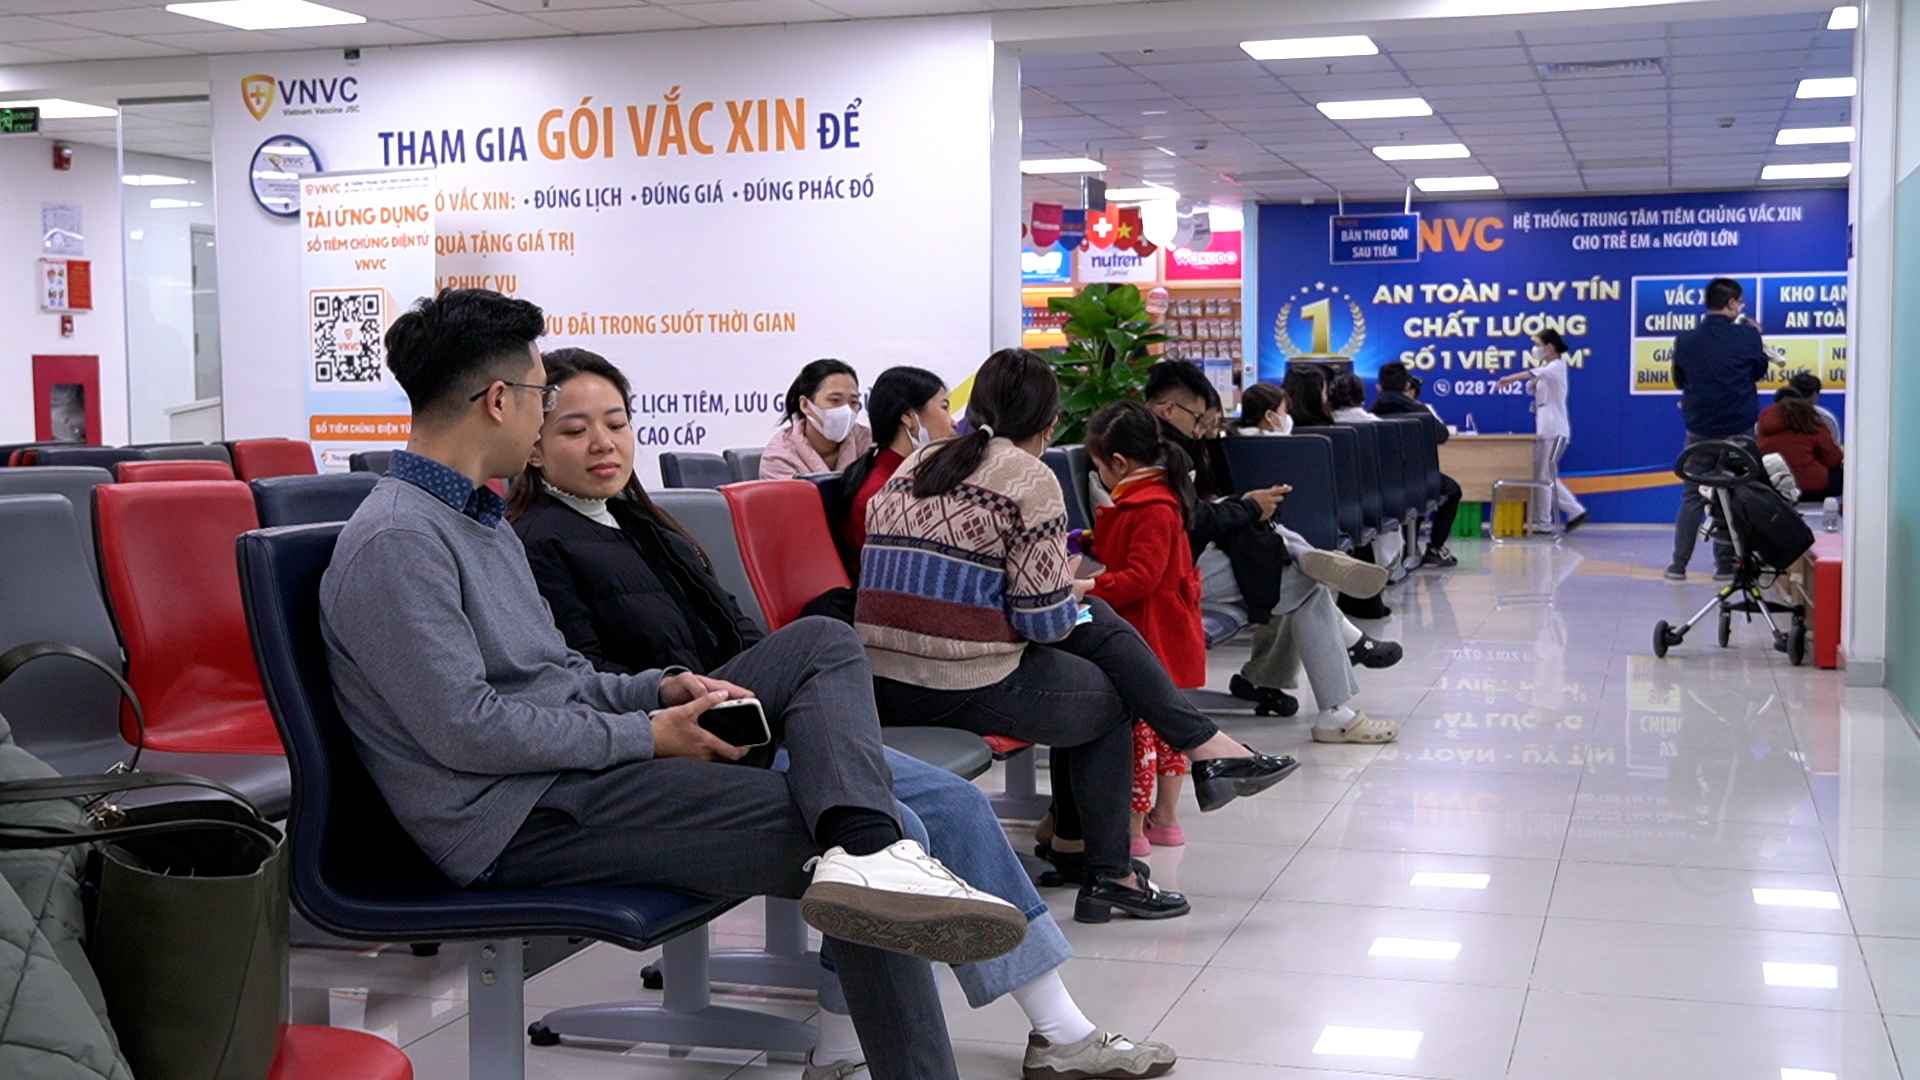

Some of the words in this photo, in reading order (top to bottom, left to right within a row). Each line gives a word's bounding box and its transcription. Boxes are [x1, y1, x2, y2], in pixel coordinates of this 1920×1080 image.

[278, 76, 358, 105] VNVC
[282, 108, 312, 116] Vietnam
[315, 107, 343, 115] Vaccine
[378, 129, 466, 167] THAM
[475, 126, 528, 163] GIA
[537, 96, 614, 160] GÓI
[626, 85, 715, 157] VẮC
[726, 97, 806, 153] XIN
[817, 97, 863, 150] ĐỂ
[449, 186, 479, 211] VẮC
[482, 191, 516, 211] XIN:
[534, 186, 580, 209] ĐÚNG
[586, 187, 622, 213] LỊCH
[642, 182, 690, 205] ĐÚNG
[695, 180, 724, 203] GIÁ
[743, 178, 793, 202] ĐÚNG
[799, 176, 845, 200] PHÁC
[306, 205, 331, 228] TẢI
[335, 204, 377, 227] ỨNG
[380, 204, 429, 229] DỤNG
[1513, 211, 1530, 233] HỆ
[1533, 209, 1578, 229] THỐNG
[1581, 210, 1627, 228] TRUNG
[1630, 207, 1660, 226] TÂM
[1661, 206, 1695, 225] TIÊM
[1697, 204, 1746, 224] CHỦNG
[1777, 205, 1803, 222] XIN
[435, 231, 467, 256] QUÀ
[470, 229, 513, 258] TẶNG
[517, 230, 545, 252] GIÁ
[549, 231, 575, 256] TRỊ
[1363, 227, 1389, 241] THEO
[1419, 216, 1504, 252] NVC
[1572, 234, 1600, 250] CHO
[1601, 229, 1627, 249] TRẺ
[1630, 233, 1650, 248] EM
[1663, 228, 1708, 248] NGƯỜI
[1711, 227, 1738, 246] LỚN
[355, 258, 387, 271] VNVC
[1352, 246, 1372, 258] SAU
[1372, 284, 1414, 304] AN
[1420, 278, 1500, 304] TOÀN
[1525, 281, 1567, 302] UY
[1571, 276, 1621, 301] TÍN
[1780, 286, 1815, 302] KHO
[1820, 285, 1847, 306] LẠN
[567, 311, 595, 335] ĐÃI
[600, 315, 656, 335] TRONG
[660, 308, 704, 334] SUỐT
[708, 309, 748, 333] THỜI
[753, 312, 796, 332] GIAN
[1403, 309, 1480, 338] CHẤT
[1486, 310, 1587, 337] LƯƠNG
[1644, 311, 1696, 331] CHÍNH
[1785, 311, 1809, 328] AN
[1813, 307, 1845, 328] TOÀ
[338, 342, 360, 351] VNVC
[1400, 345, 1436, 370] SỐ
[1440, 350, 1452, 369] 1
[1457, 345, 1516, 374] VIỆT
[1454, 381, 1485, 395] 028
[1638, 367, 1669, 384] BÌNH
[642, 393, 679, 418] LỊCH
[684, 391, 730, 416] TIÊM,
[734, 391, 768, 413] LƯU
[637, 426, 669, 446] CAO
[674, 420, 707, 446] CẤP
